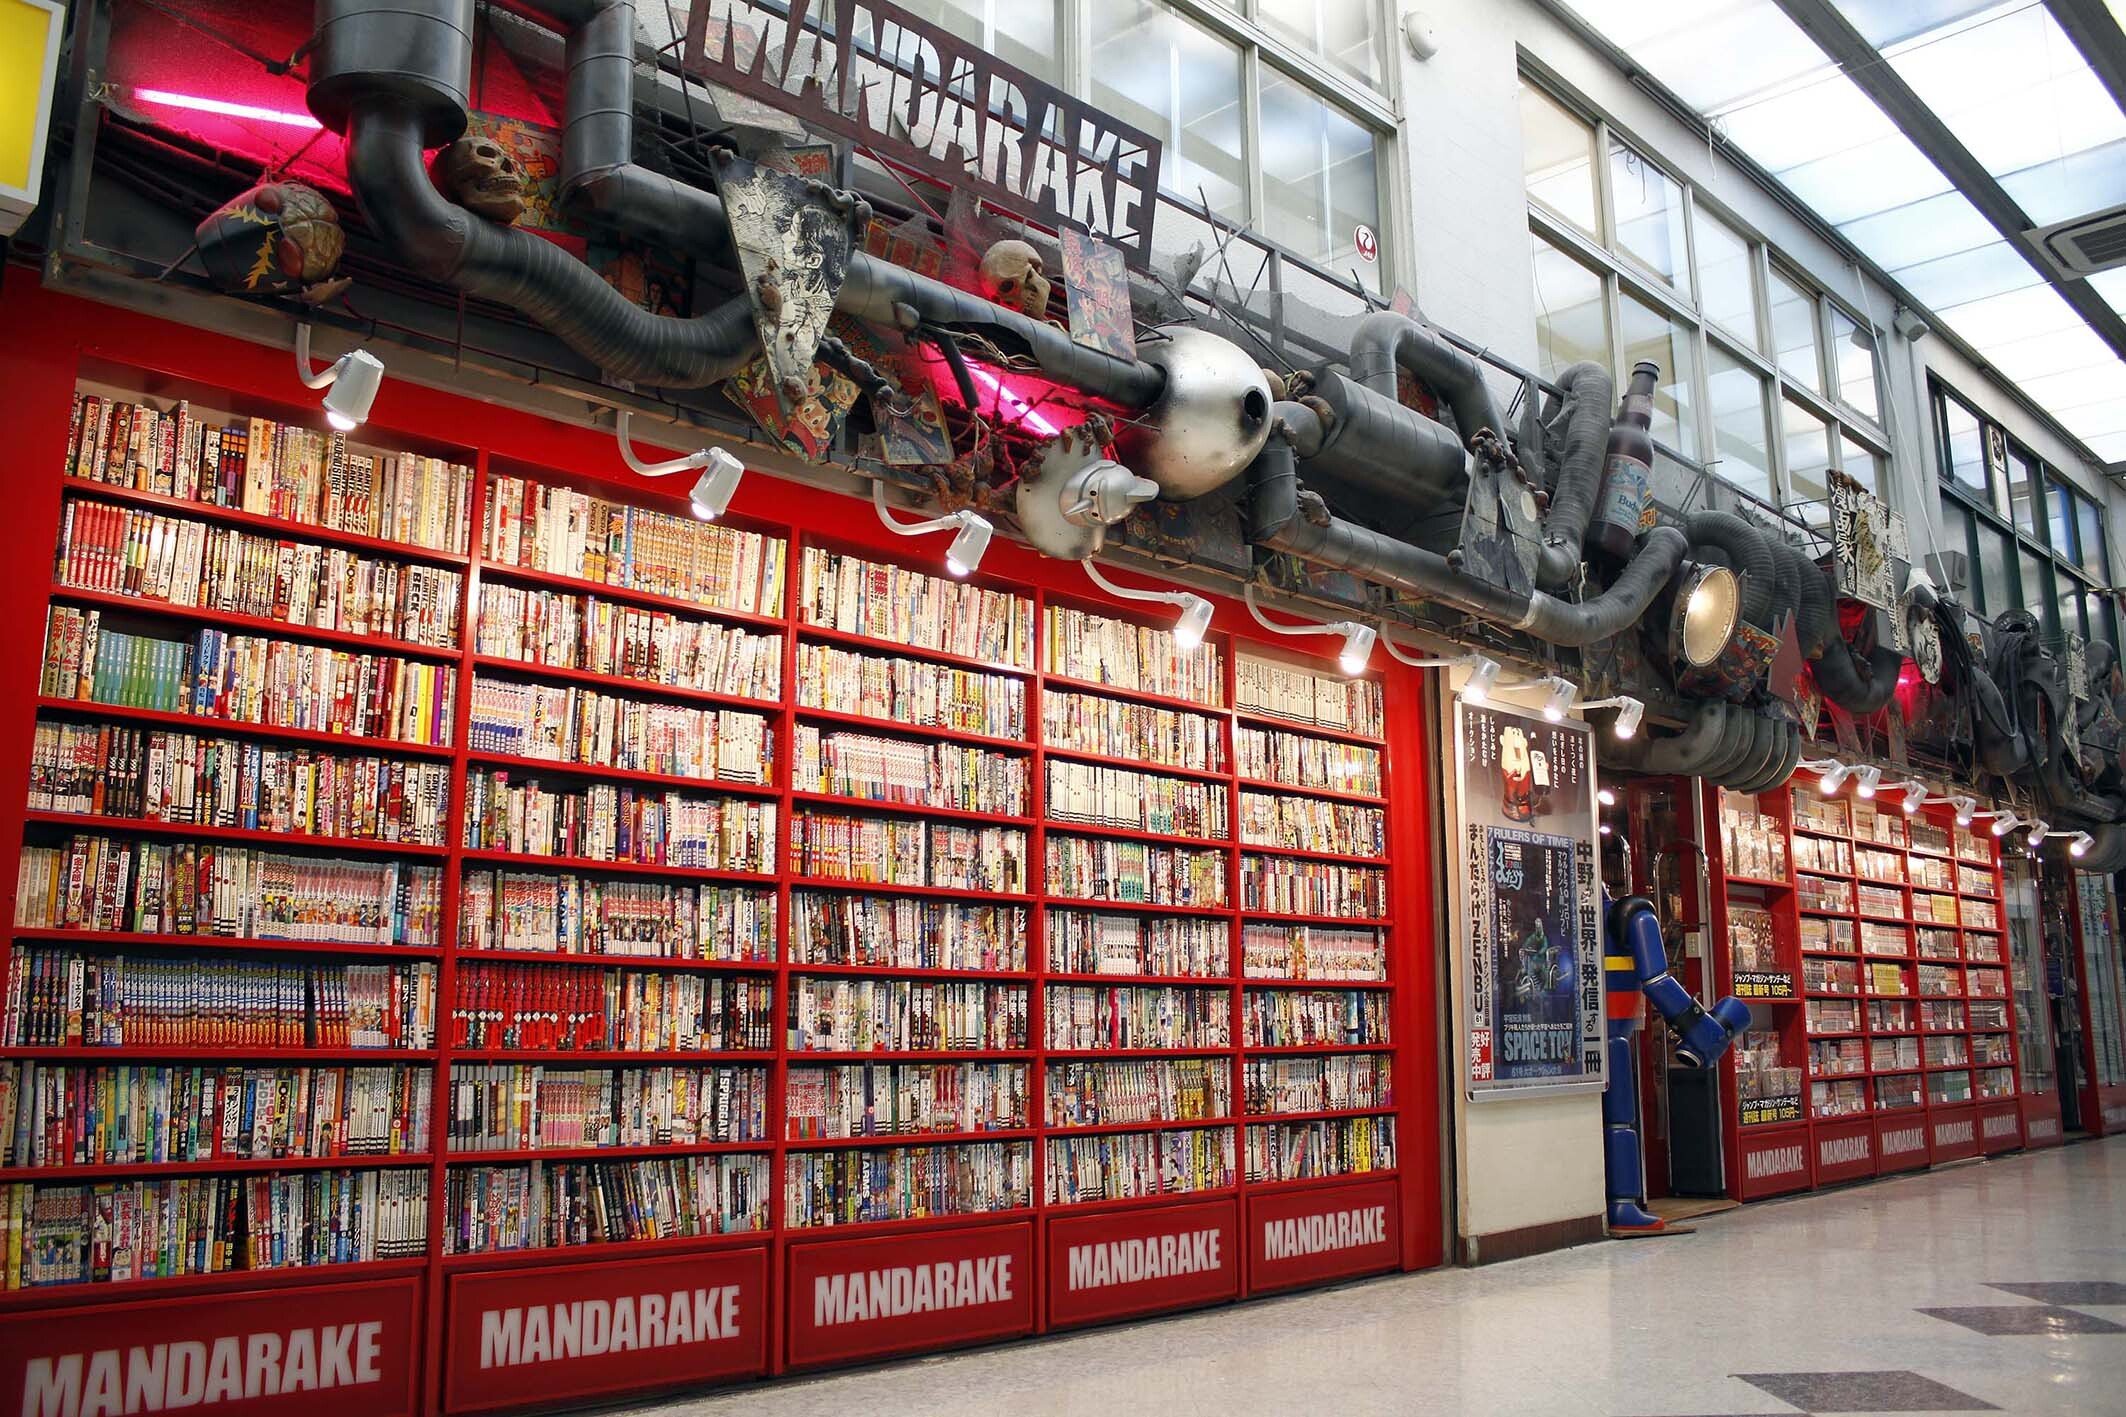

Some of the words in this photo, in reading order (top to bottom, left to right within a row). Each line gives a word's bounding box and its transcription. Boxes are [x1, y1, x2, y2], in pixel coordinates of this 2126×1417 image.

[702, 0, 1148, 247] MANDARAKE
[411, 572, 421, 612] BECK
[534, 694, 543, 720] GTO
[1493, 827, 1531, 843] RULERS
[1531, 833, 1544, 845] OF
[1547, 834, 1569, 848] TIME
[72, 857, 83, 882] 金太郎
[1504, 1031, 1546, 1062] SPACE
[717, 1077, 730, 1137] SPRIGGAN
[1820, 1135, 1870, 1166] MANDARAKE
[1882, 1127, 1925, 1155] MANDARAKE
[861, 1160, 871, 1198] ARMS
[1747, 1145, 1803, 1179] MANDARAKE
[1264, 1205, 1387, 1261] MANDARAKE
[1068, 1228, 1221, 1291] MANDARAKE
[814, 1254, 1013, 1328] MANDARAKE
[480, 1284, 741, 1370] MANDARAKE
[22, 1320, 383, 1417] MANDARAKE
